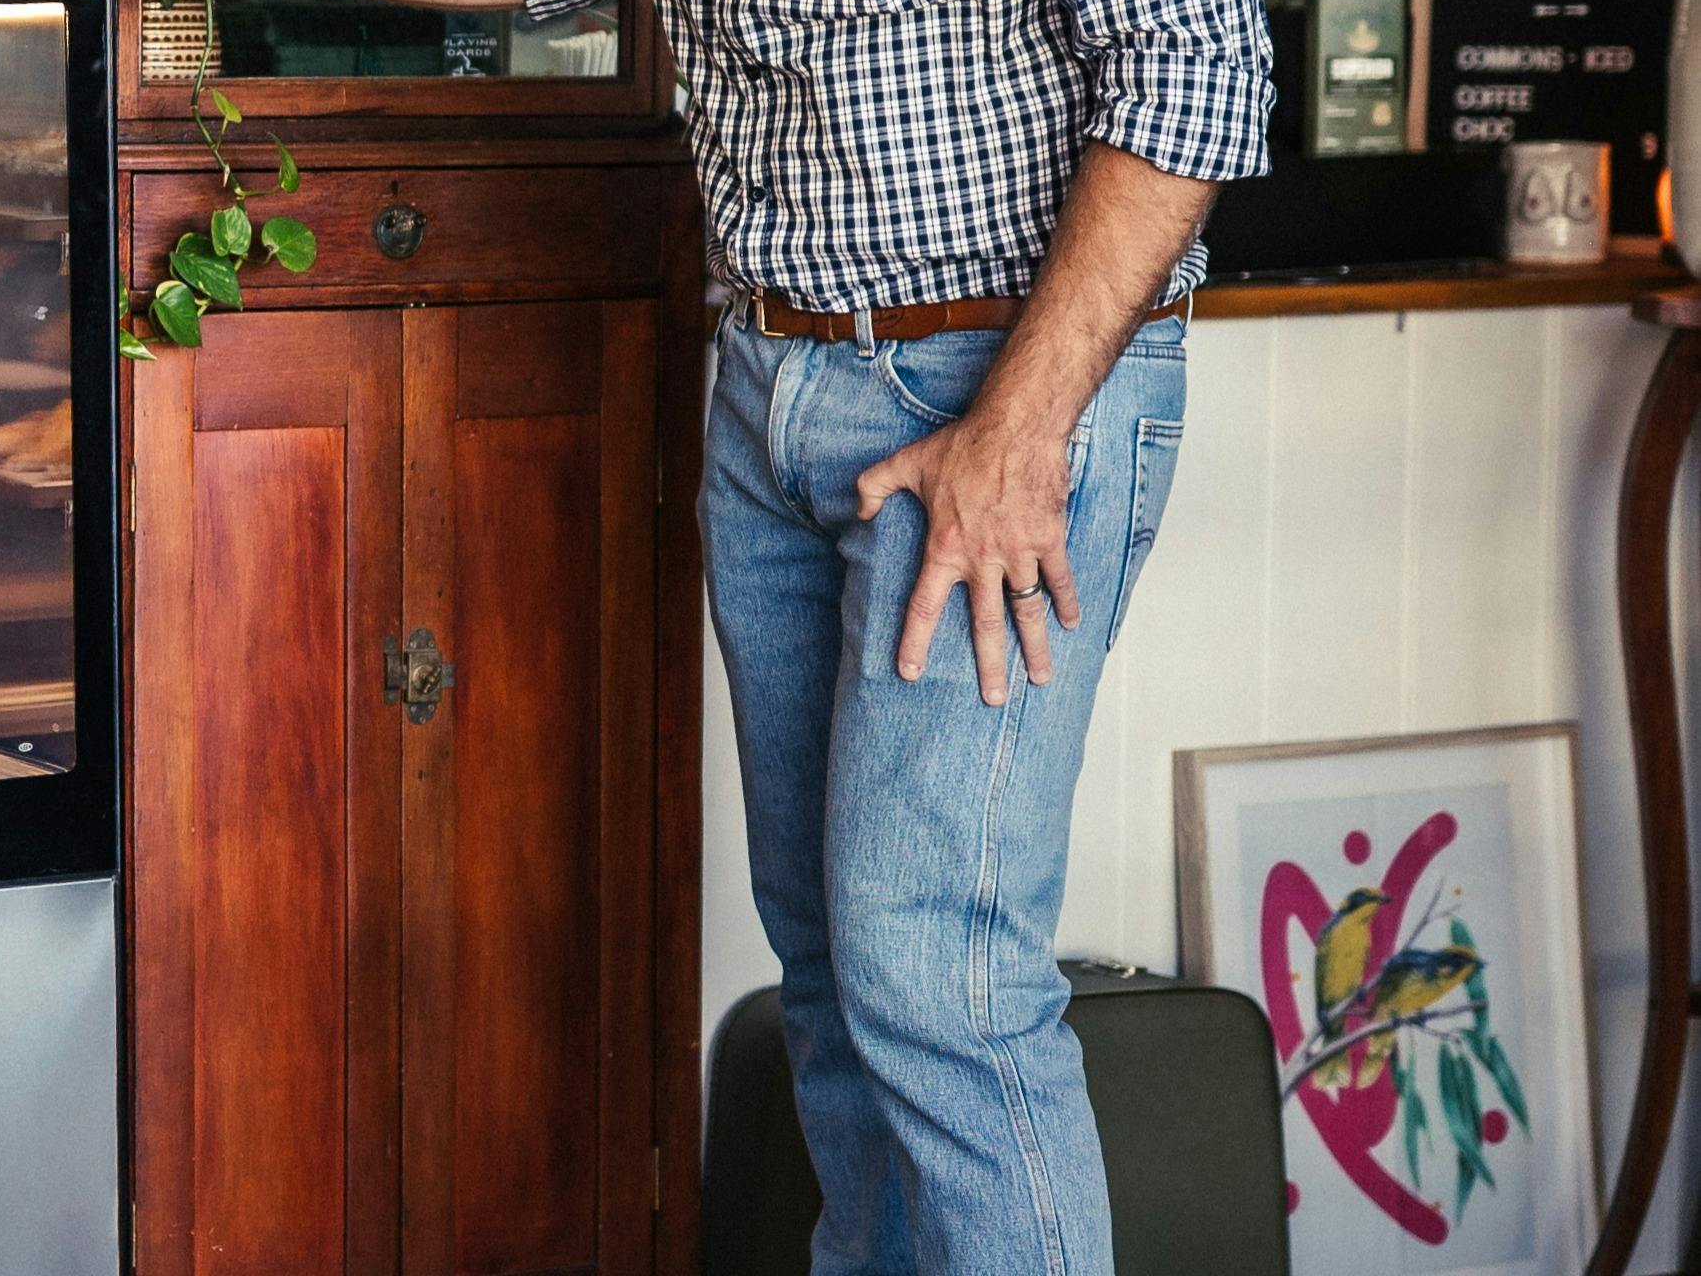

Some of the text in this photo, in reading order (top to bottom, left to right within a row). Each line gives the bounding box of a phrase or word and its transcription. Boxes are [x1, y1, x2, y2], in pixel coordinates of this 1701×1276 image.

[1456, 45, 1564, 72] COMMONS
[1454, 84, 1534, 112] COFFEE
[1453, 115, 1515, 141] CHOC
